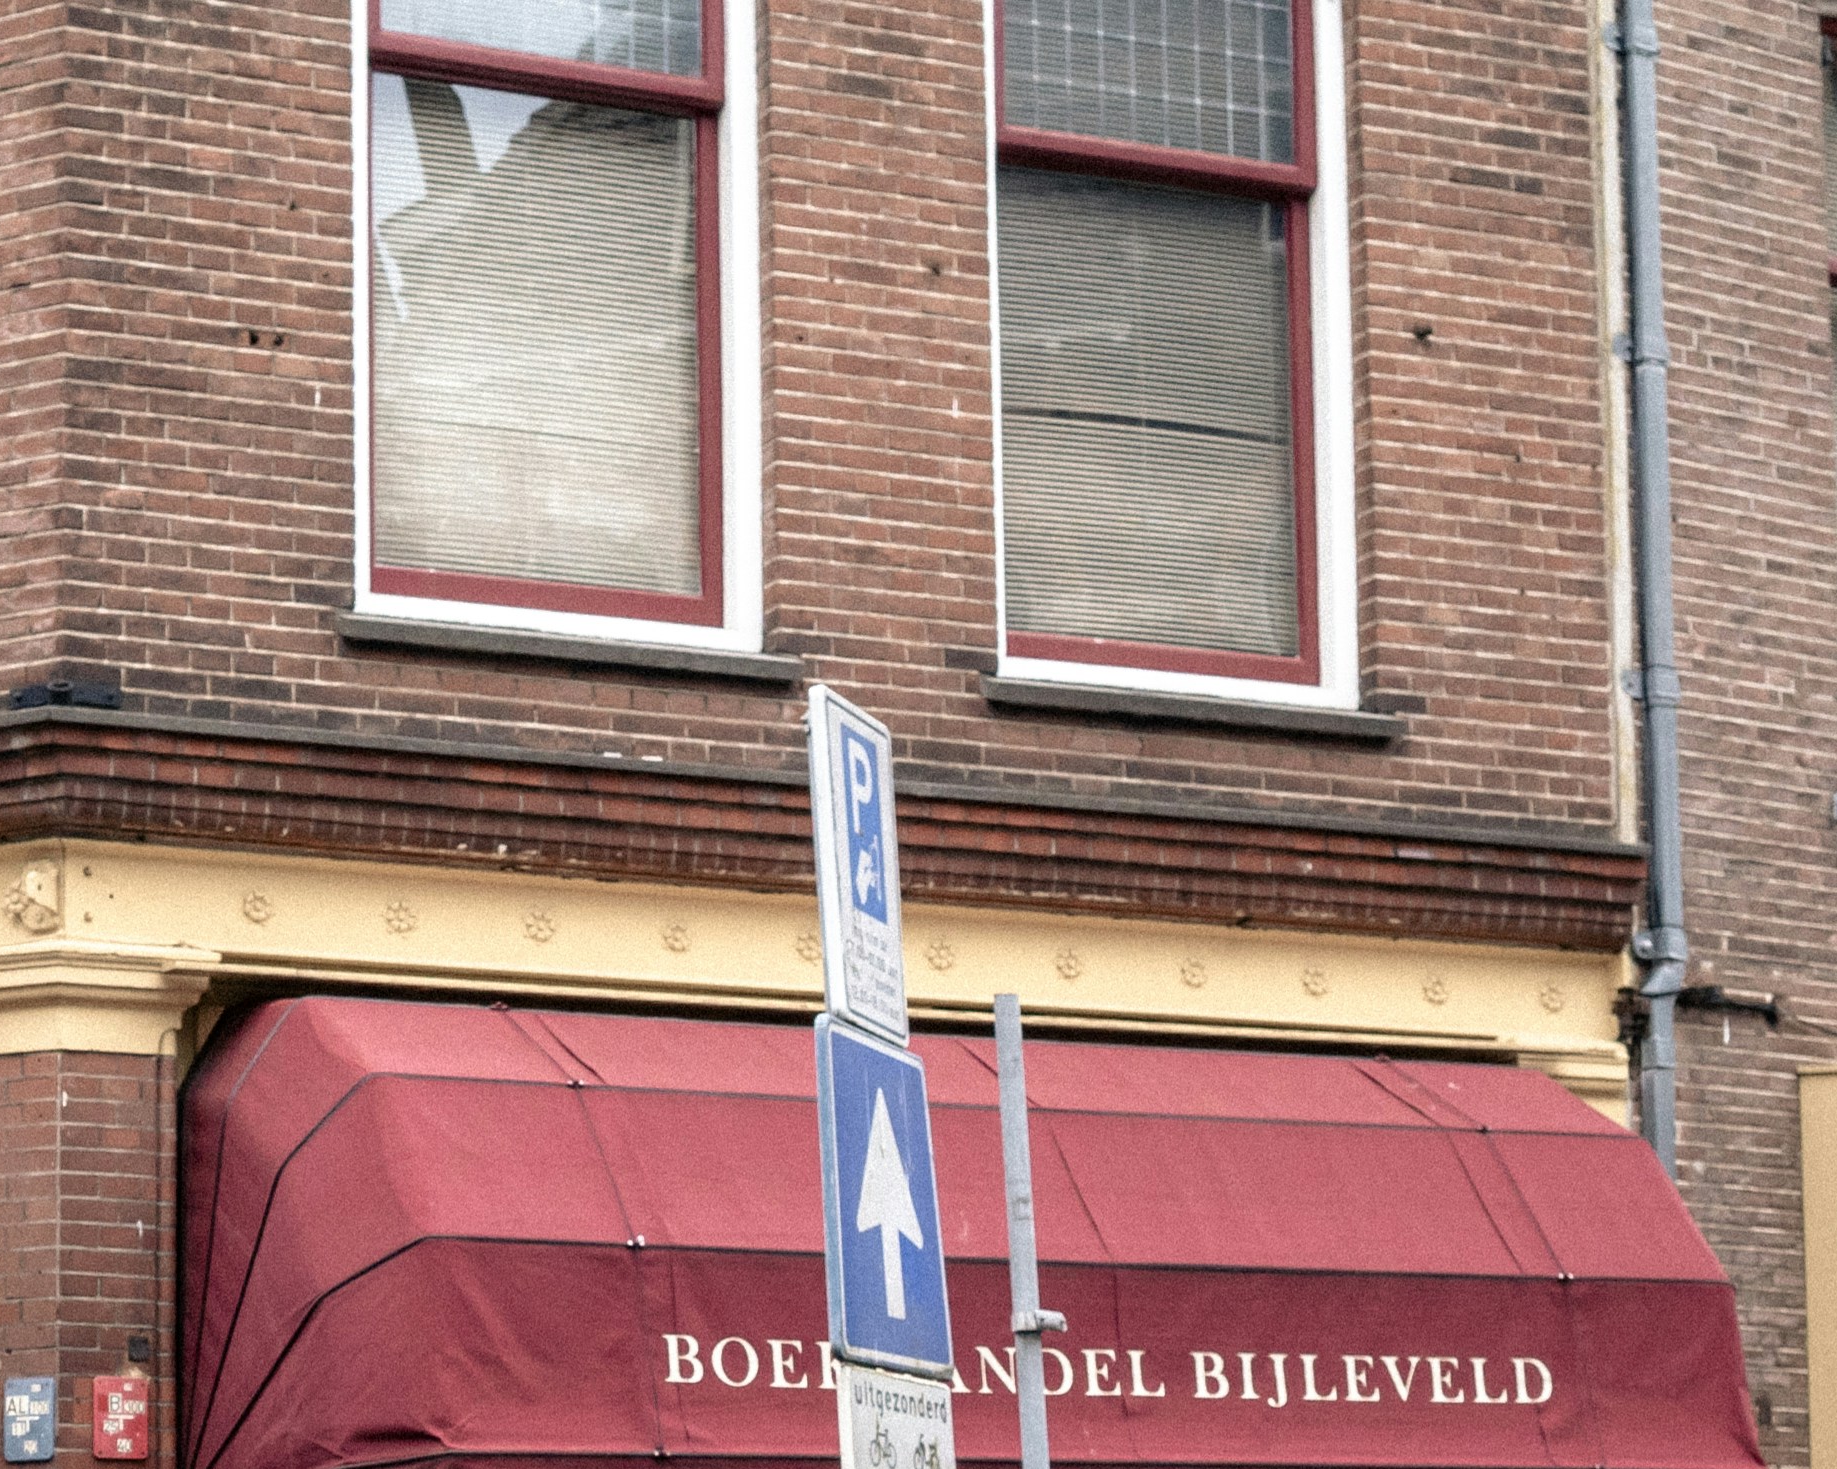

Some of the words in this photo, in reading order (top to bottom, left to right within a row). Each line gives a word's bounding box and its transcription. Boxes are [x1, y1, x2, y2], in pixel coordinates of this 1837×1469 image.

[847, 736, 873, 834] P
[853, 1380, 949, 1424] uitgezonderd
[1194, 1350, 1555, 1409] BIJLEVELD
